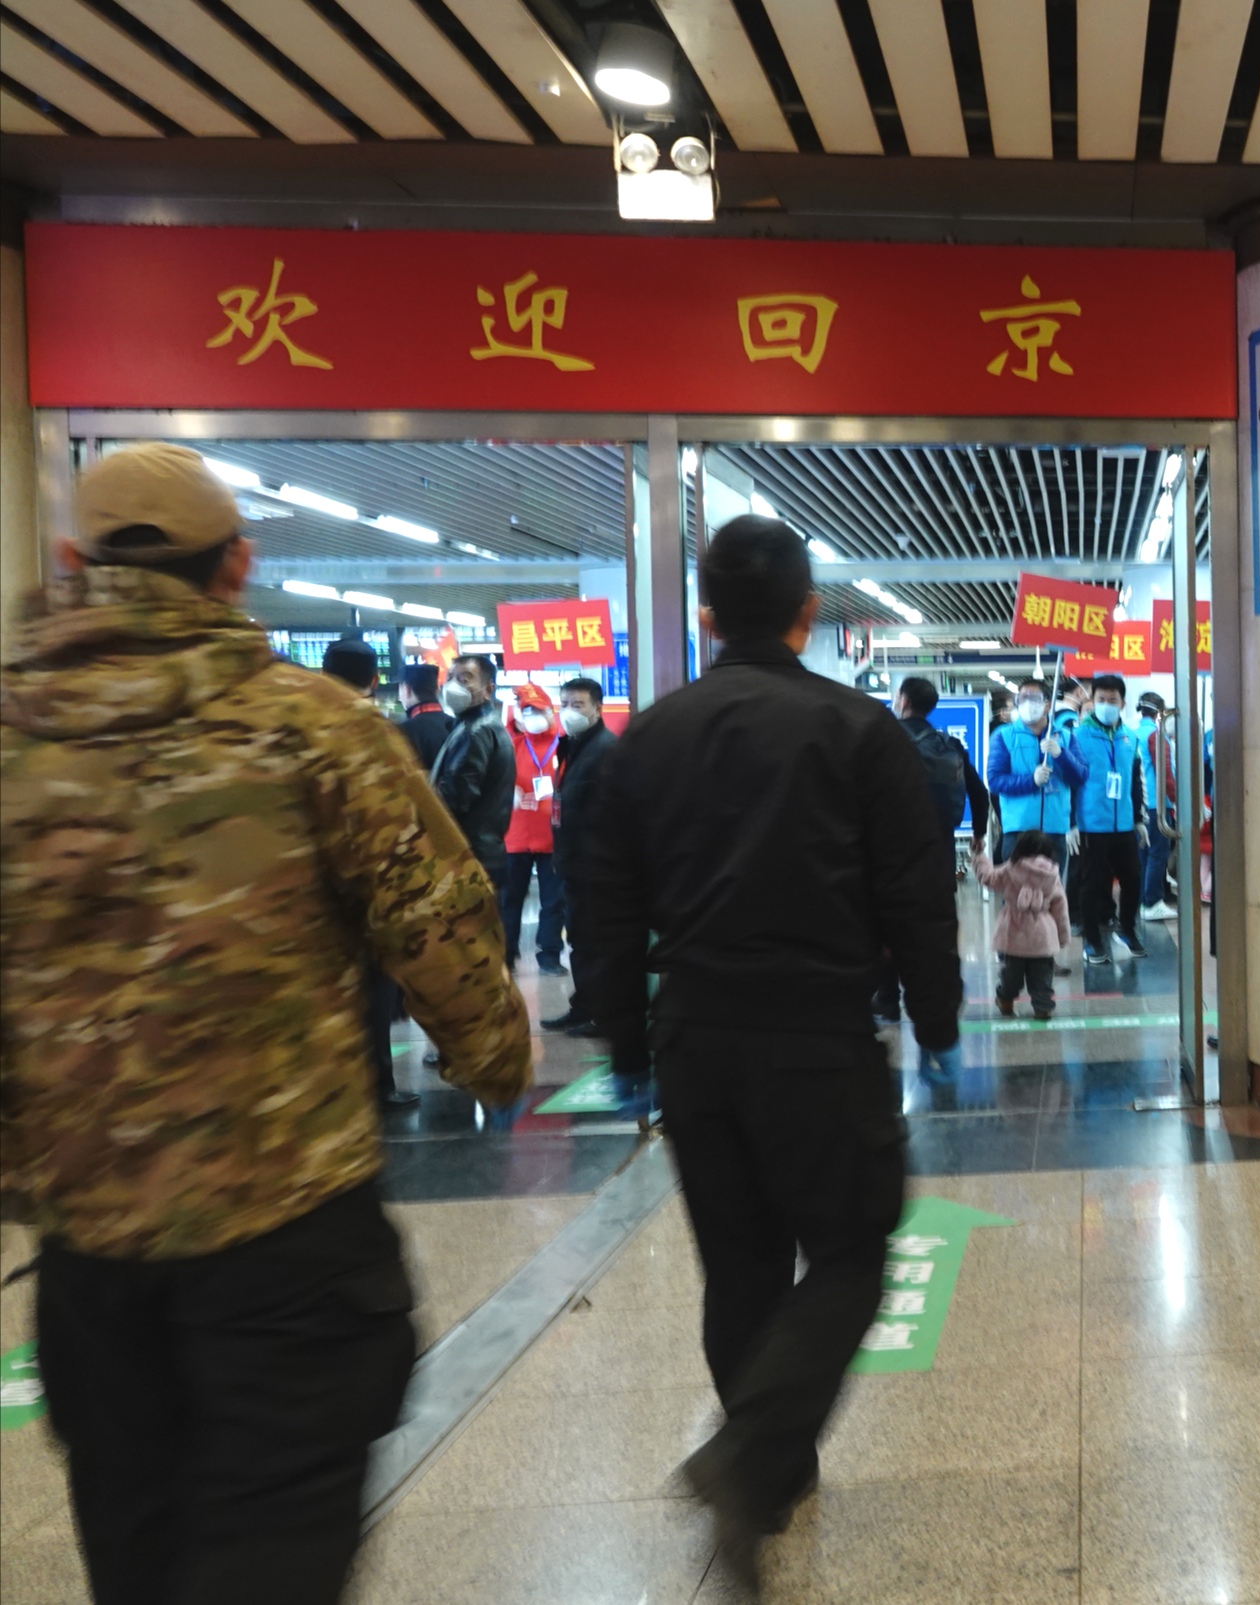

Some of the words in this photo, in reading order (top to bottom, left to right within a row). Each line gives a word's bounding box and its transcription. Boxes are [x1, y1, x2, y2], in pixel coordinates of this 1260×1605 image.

[206, 257, 1082, 383] 欢迎回京
[511, 615, 606, 654] 昌平区
[1021, 592, 1110, 638] 朝阳区
